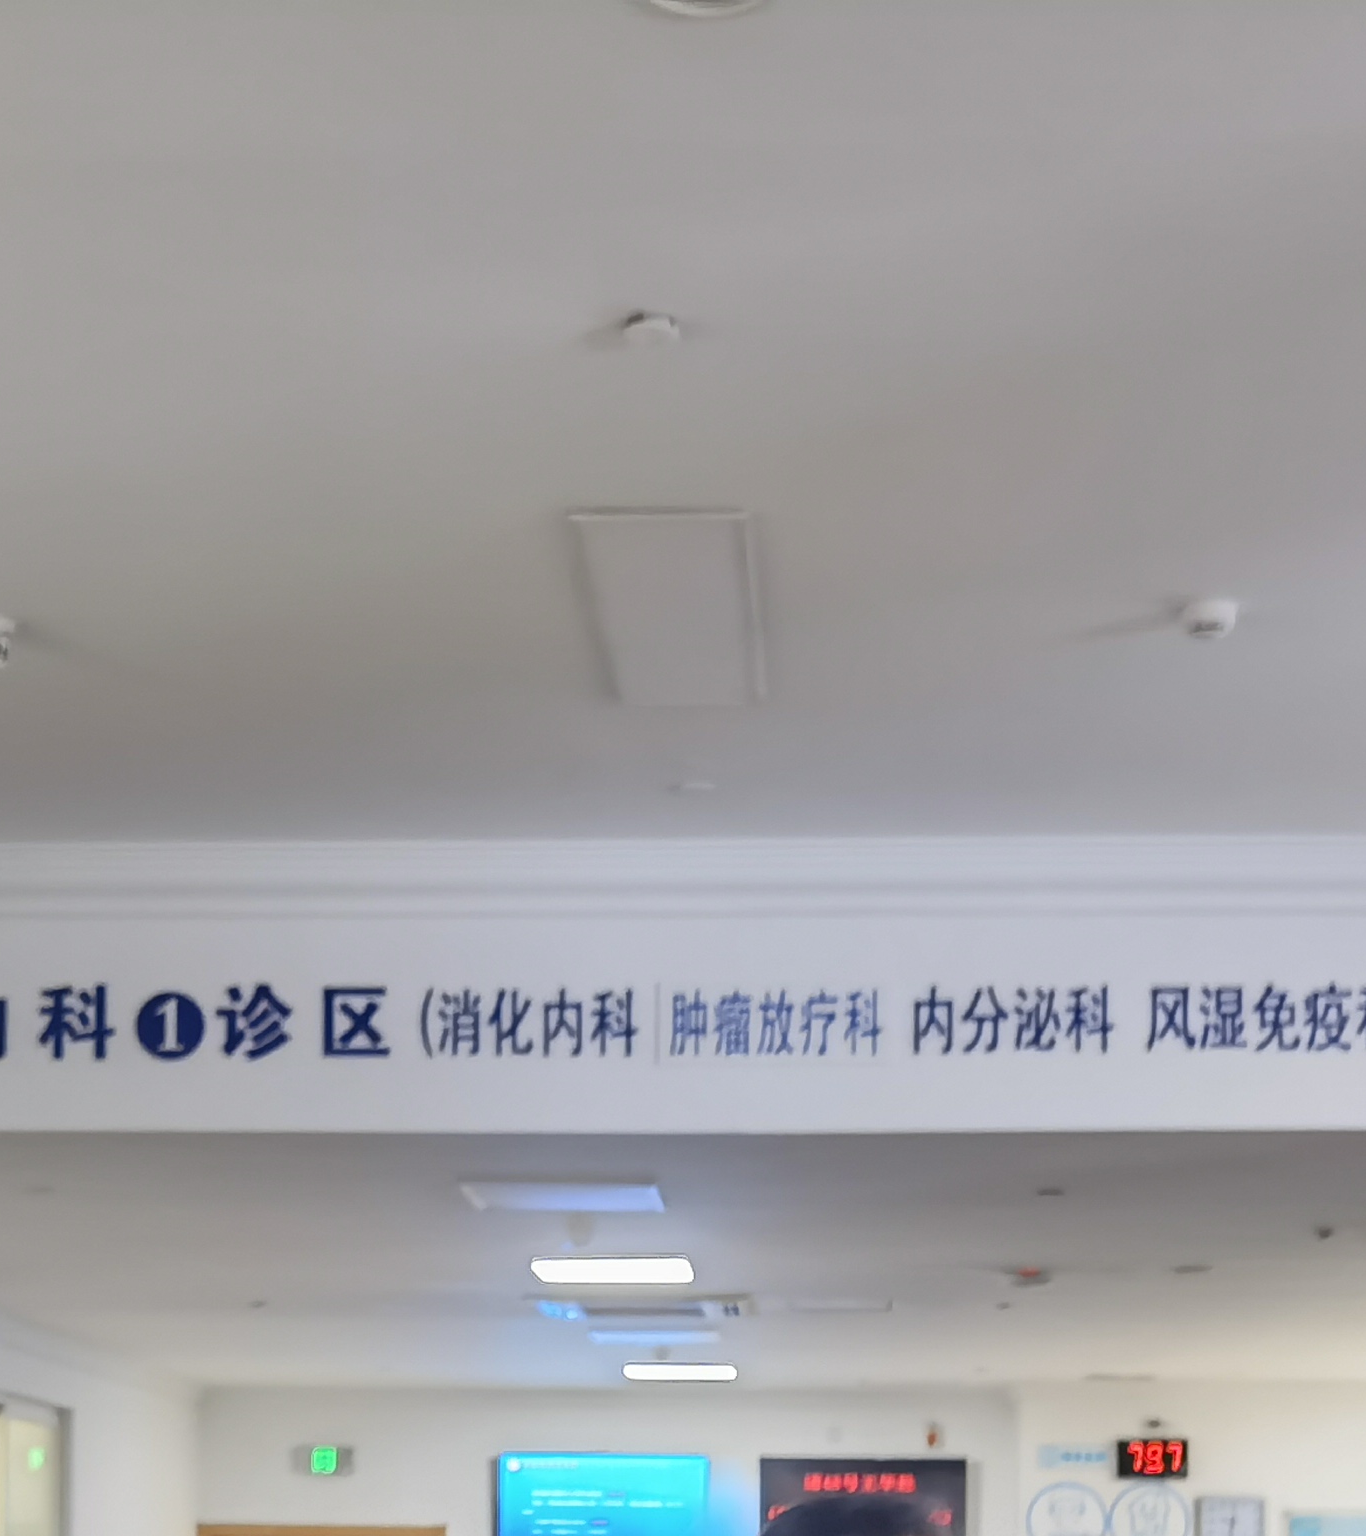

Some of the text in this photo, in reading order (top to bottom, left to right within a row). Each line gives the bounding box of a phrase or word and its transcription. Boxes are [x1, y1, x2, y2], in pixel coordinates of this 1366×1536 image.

[669, 988, 883, 1057] 肿瘤放疗科
[911, 983, 1116, 1056] 内分泌科
